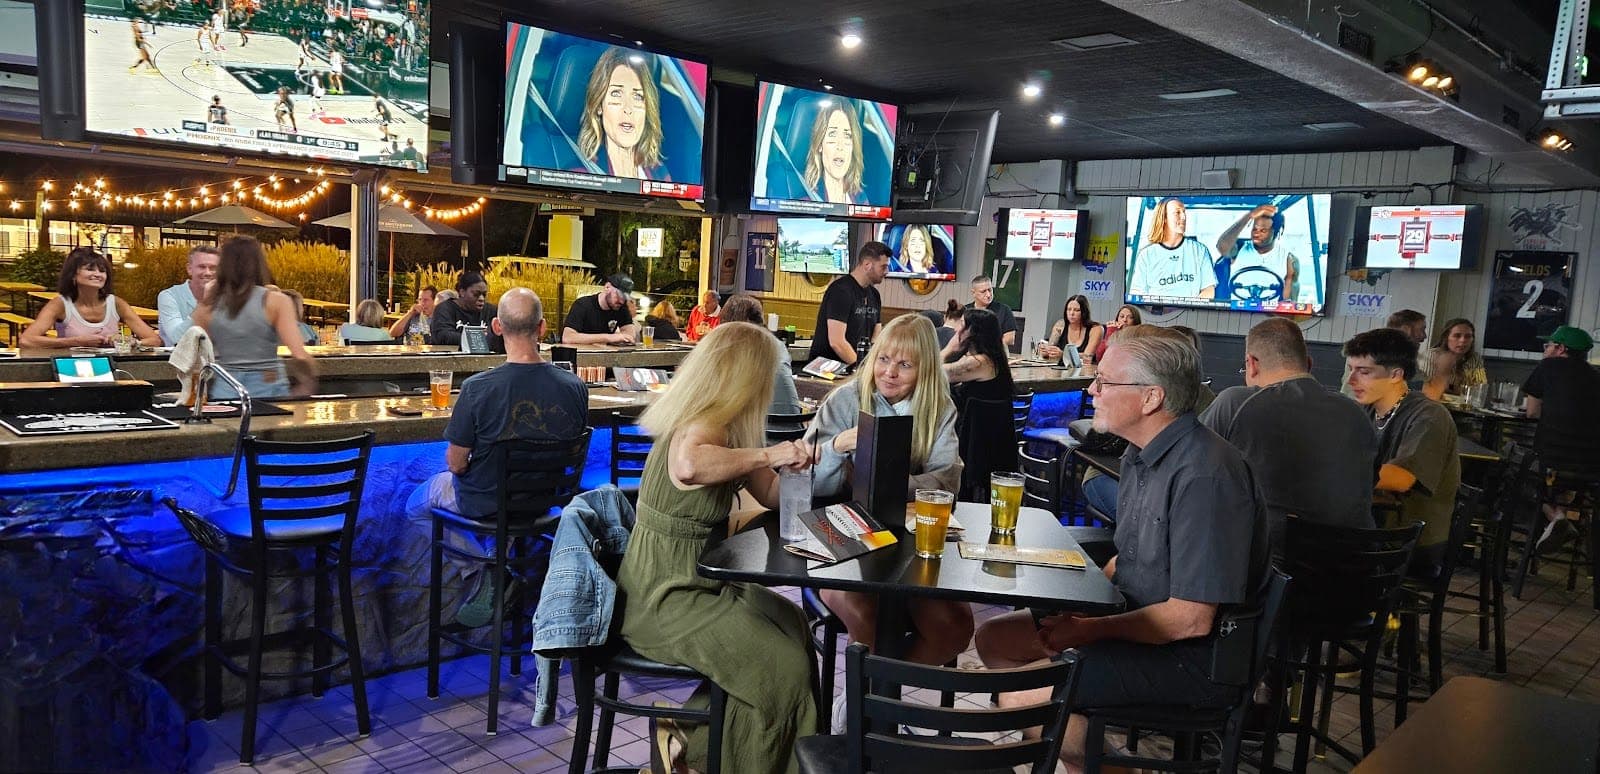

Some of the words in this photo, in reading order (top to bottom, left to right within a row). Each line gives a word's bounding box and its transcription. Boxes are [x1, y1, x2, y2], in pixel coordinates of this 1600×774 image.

[186, 133, 220, 142] PHOENIX
[1405, 229, 1425, 242] 29
[755, 247, 767, 270] 11
[991, 258, 1015, 289] 17
[1159, 273, 1195, 286] adidas
[1084, 280, 1111, 291] SKYY
[1347, 294, 1386, 307] SKYY
[1516, 279, 1544, 319] 2
